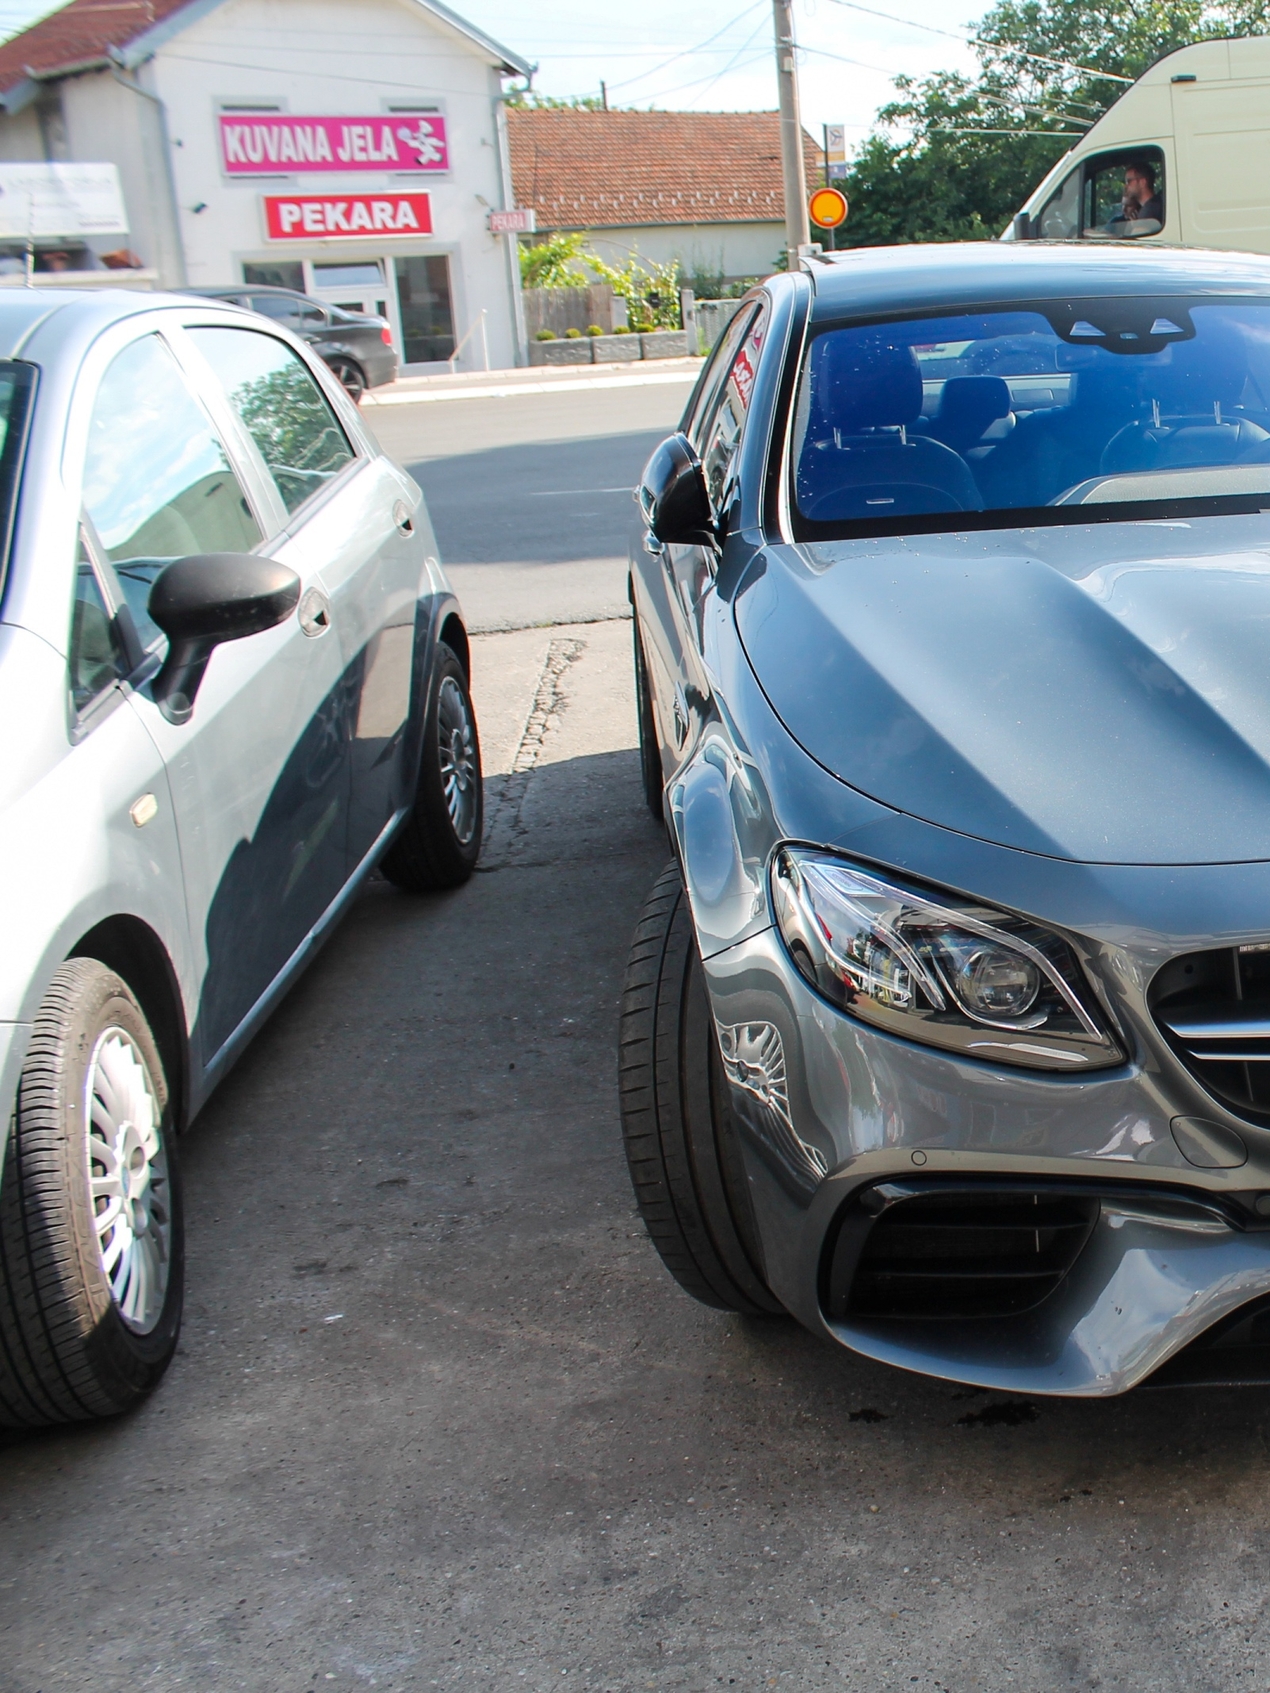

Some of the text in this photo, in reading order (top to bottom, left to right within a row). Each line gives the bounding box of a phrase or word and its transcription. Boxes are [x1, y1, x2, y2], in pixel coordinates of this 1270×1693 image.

[223, 124, 399, 164] KUVANA JELA
[278, 200, 419, 233] PEKARA
[491, 212, 525, 230] PEKARA
